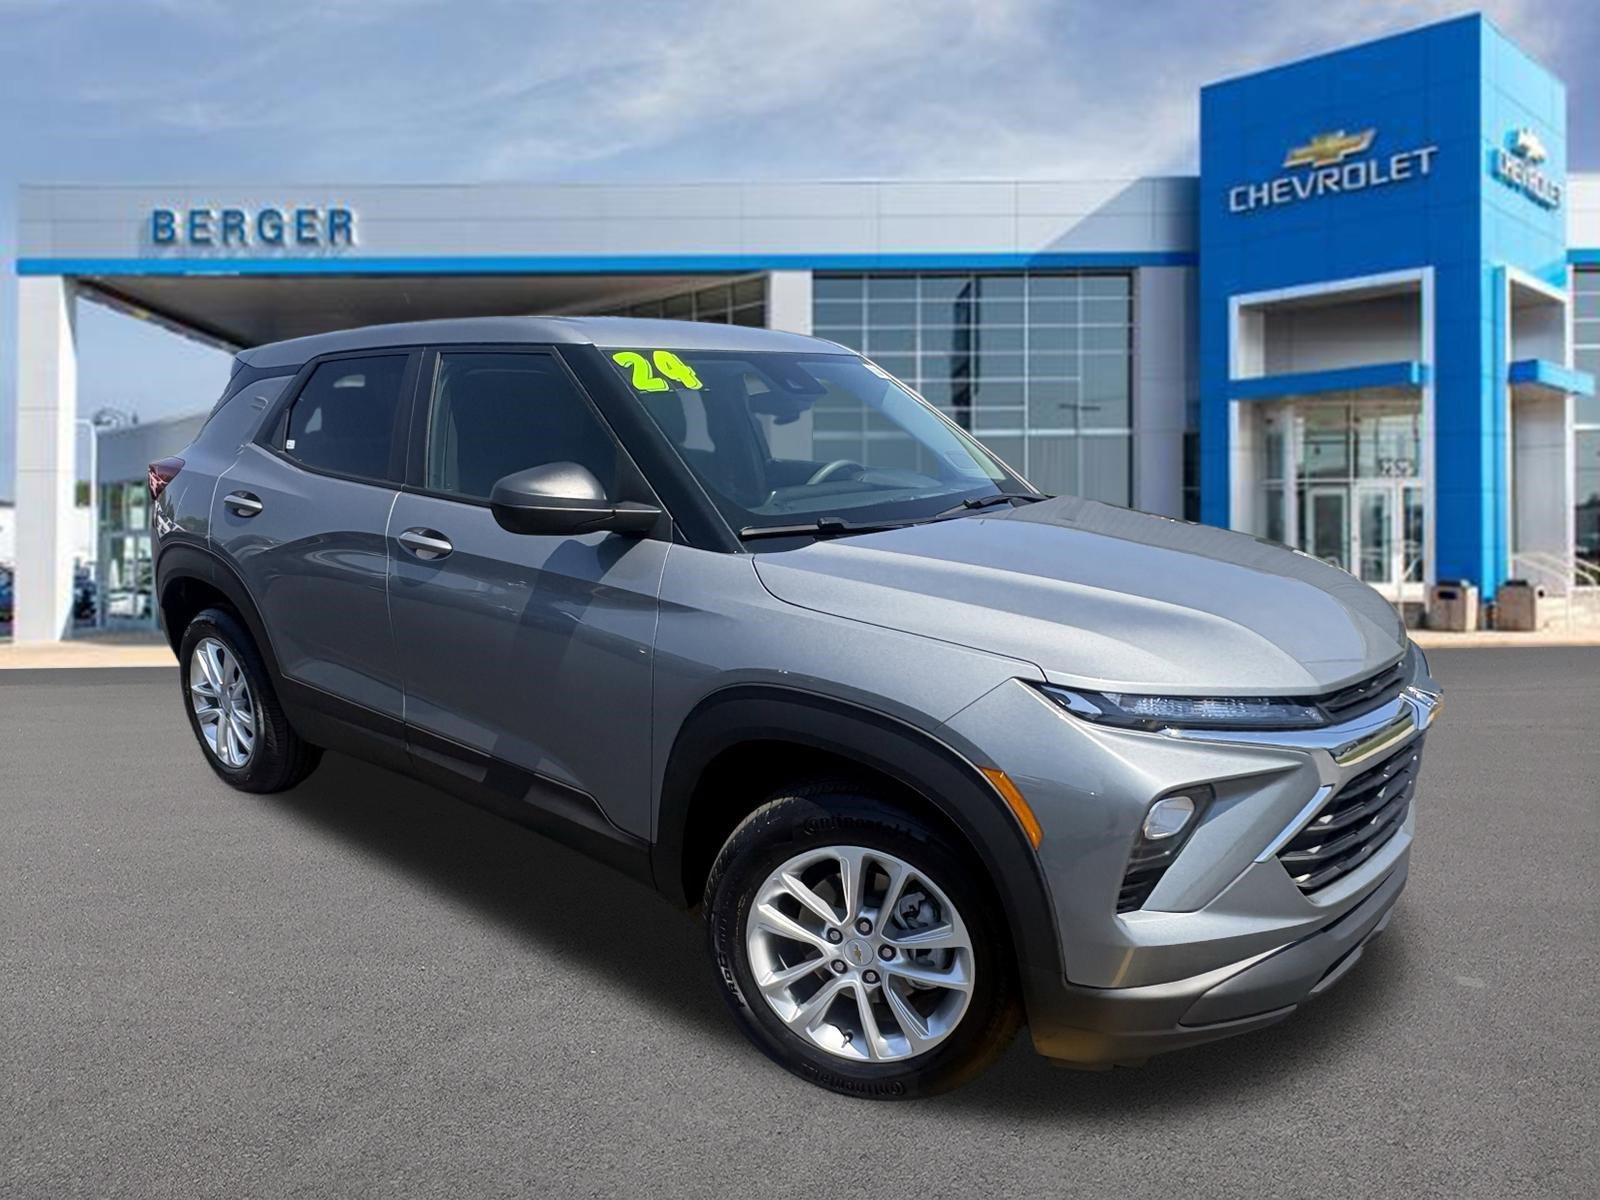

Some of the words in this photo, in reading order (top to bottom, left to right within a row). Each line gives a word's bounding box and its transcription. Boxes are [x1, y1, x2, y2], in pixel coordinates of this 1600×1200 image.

[1229, 146, 1438, 213] CHEVROLET
[152, 208, 355, 246] BERGER
[612, 350, 703, 392] 24
